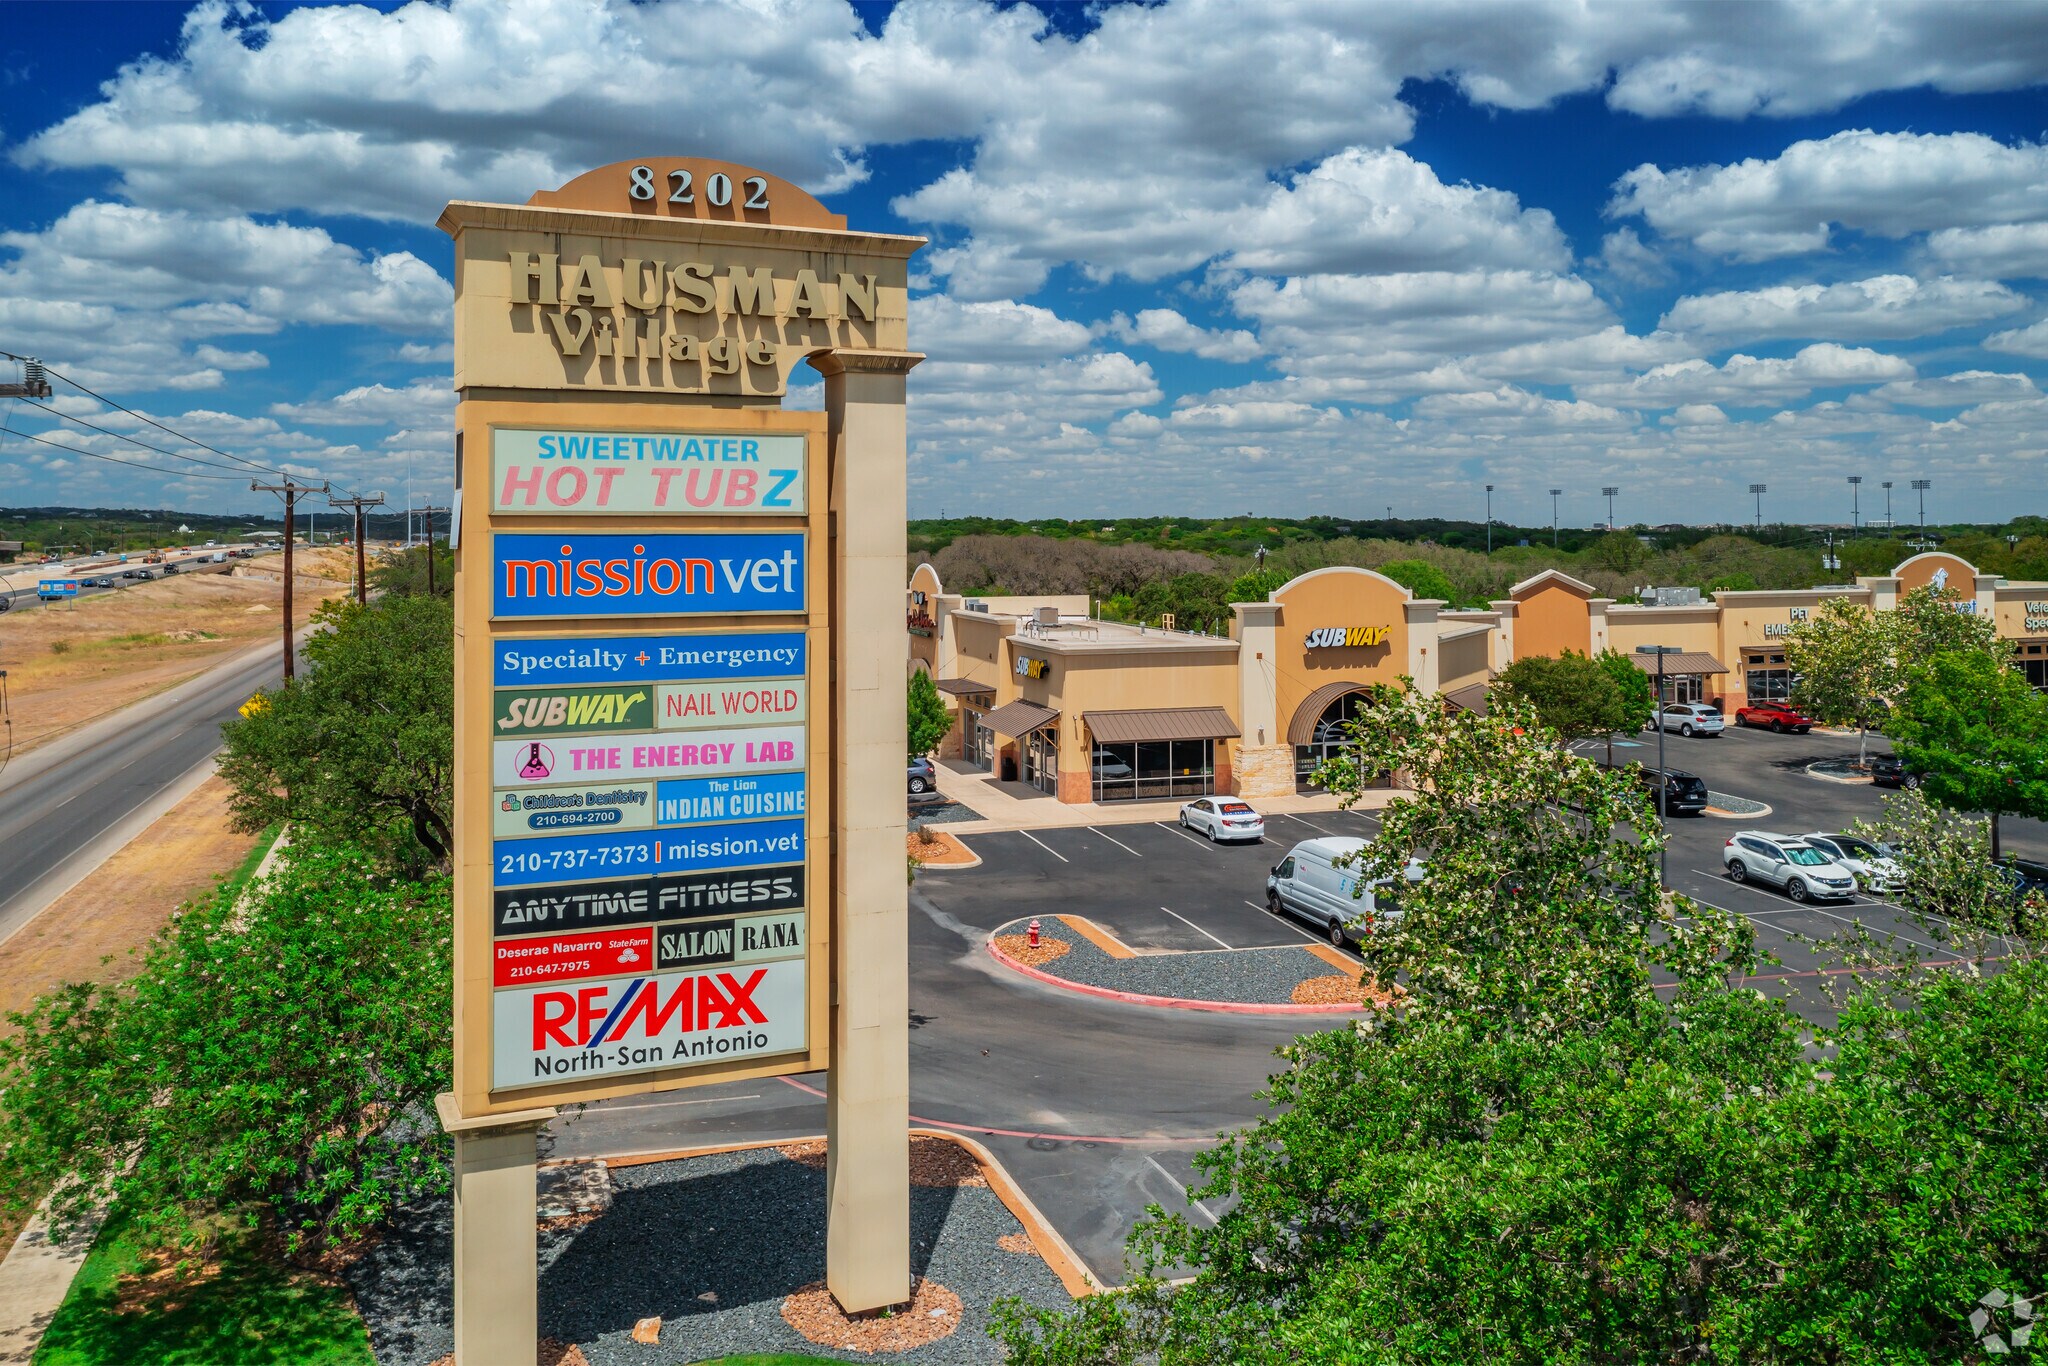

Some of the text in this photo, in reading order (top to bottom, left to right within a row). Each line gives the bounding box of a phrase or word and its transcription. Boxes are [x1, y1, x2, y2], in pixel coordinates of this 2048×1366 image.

[628, 166, 770, 210] 8202
[508, 251, 876, 322] HAUSMAN
[548, 308, 777, 375] Village
[538, 436, 760, 462] SWEETWATER
[500, 465, 799, 507] HOT TUBZ
[1790, 607, 1809, 619] PET
[1305, 624, 1392, 648] SUBWAY
[503, 648, 627, 675] Specialty
[659, 646, 799, 665] Emergency
[497, 690, 646, 731] SUBWAY
[667, 689, 798, 717] NAIL WORLD
[569, 741, 794, 771] THE ENERGY LAB
[523, 794, 583, 810] Children's
[585, 789, 648, 806] Dentistry
[708, 779, 757, 793] The Lion
[536, 811, 615, 826] 210-694-2700
[658, 790, 804, 821] INDIAN CUISINE
[501, 832, 799, 874] 210-737-7373 mission.vet
[501, 877, 793, 924] ANYTIME FITNESS
[497, 941, 602, 959] Deserae Navarro
[661, 922, 800, 961] SALON RANA
[510, 960, 590, 977] 210-647-7975
[532, 968, 769, 1052] RE/MAX
[534, 1030, 769, 1077] North-San Antonio
